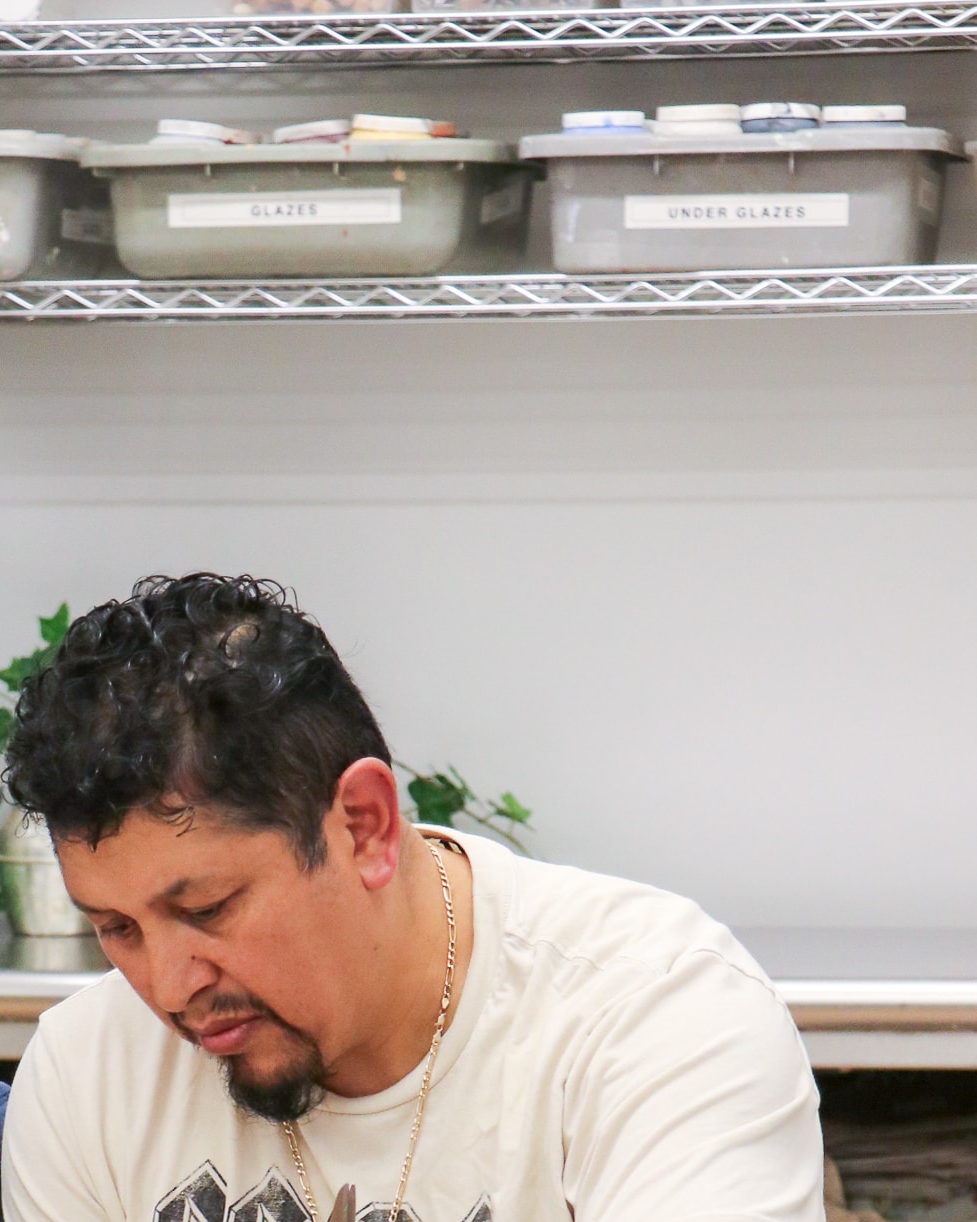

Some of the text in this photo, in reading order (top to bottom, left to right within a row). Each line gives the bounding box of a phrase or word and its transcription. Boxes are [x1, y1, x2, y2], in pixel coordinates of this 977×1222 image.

[250, 203, 319, 218] GLAZES
[667, 205, 808, 220] UNDER GLAZES
